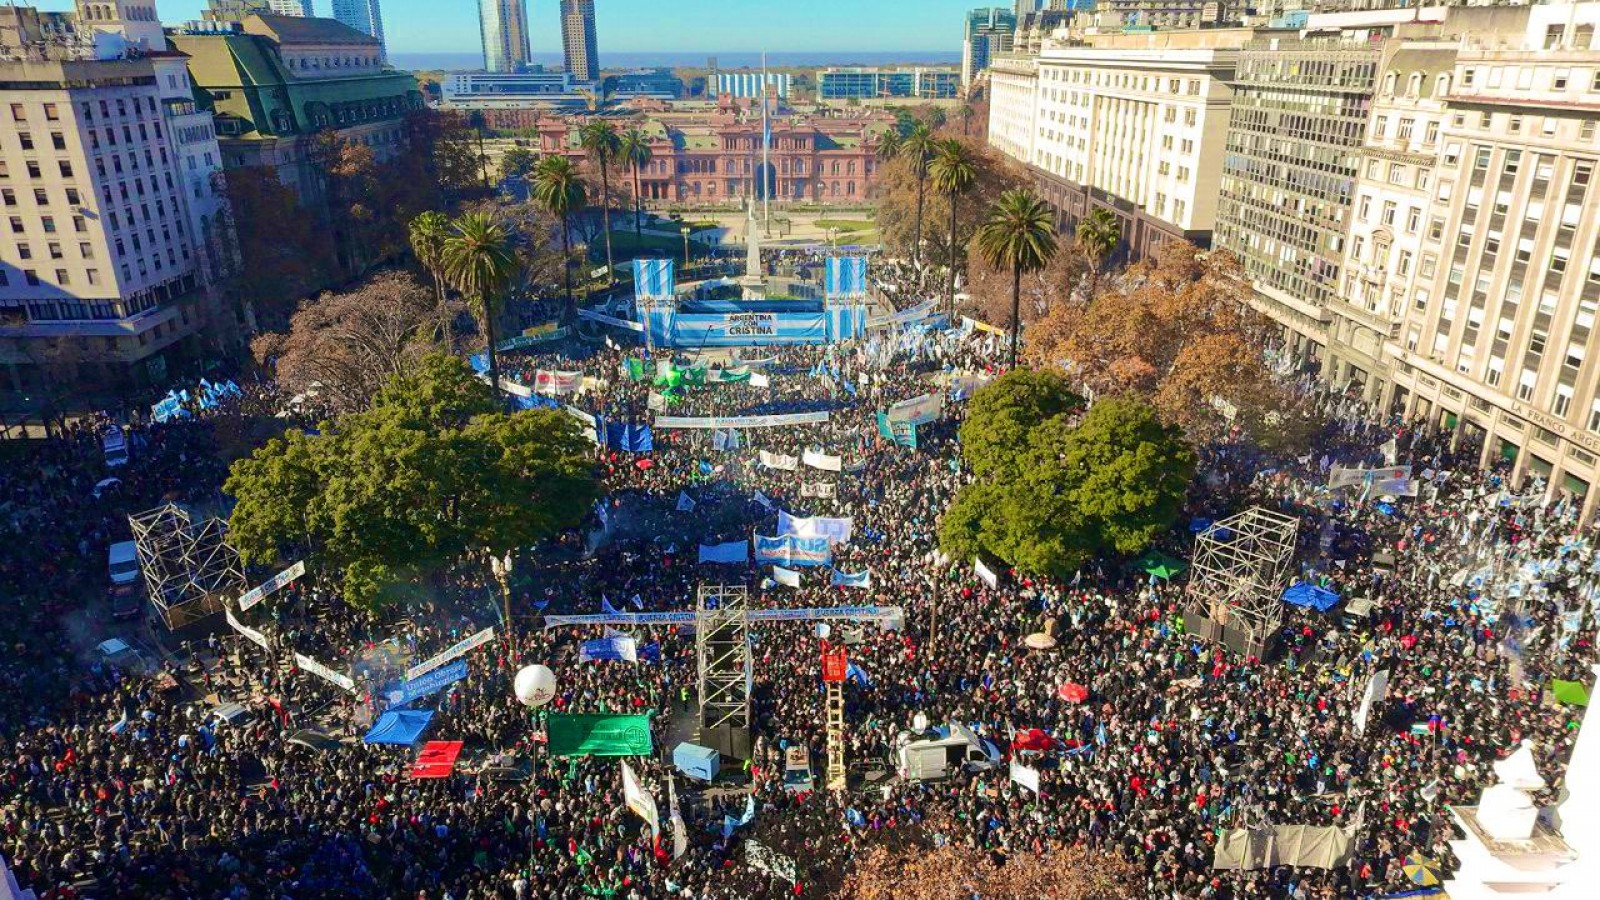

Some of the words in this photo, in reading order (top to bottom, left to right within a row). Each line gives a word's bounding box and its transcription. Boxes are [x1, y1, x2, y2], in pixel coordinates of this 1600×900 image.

[729, 327, 773, 335] CRISTINA
[1511, 401, 1522, 414] LA
[1528, 410, 1565, 433] FRANCO
